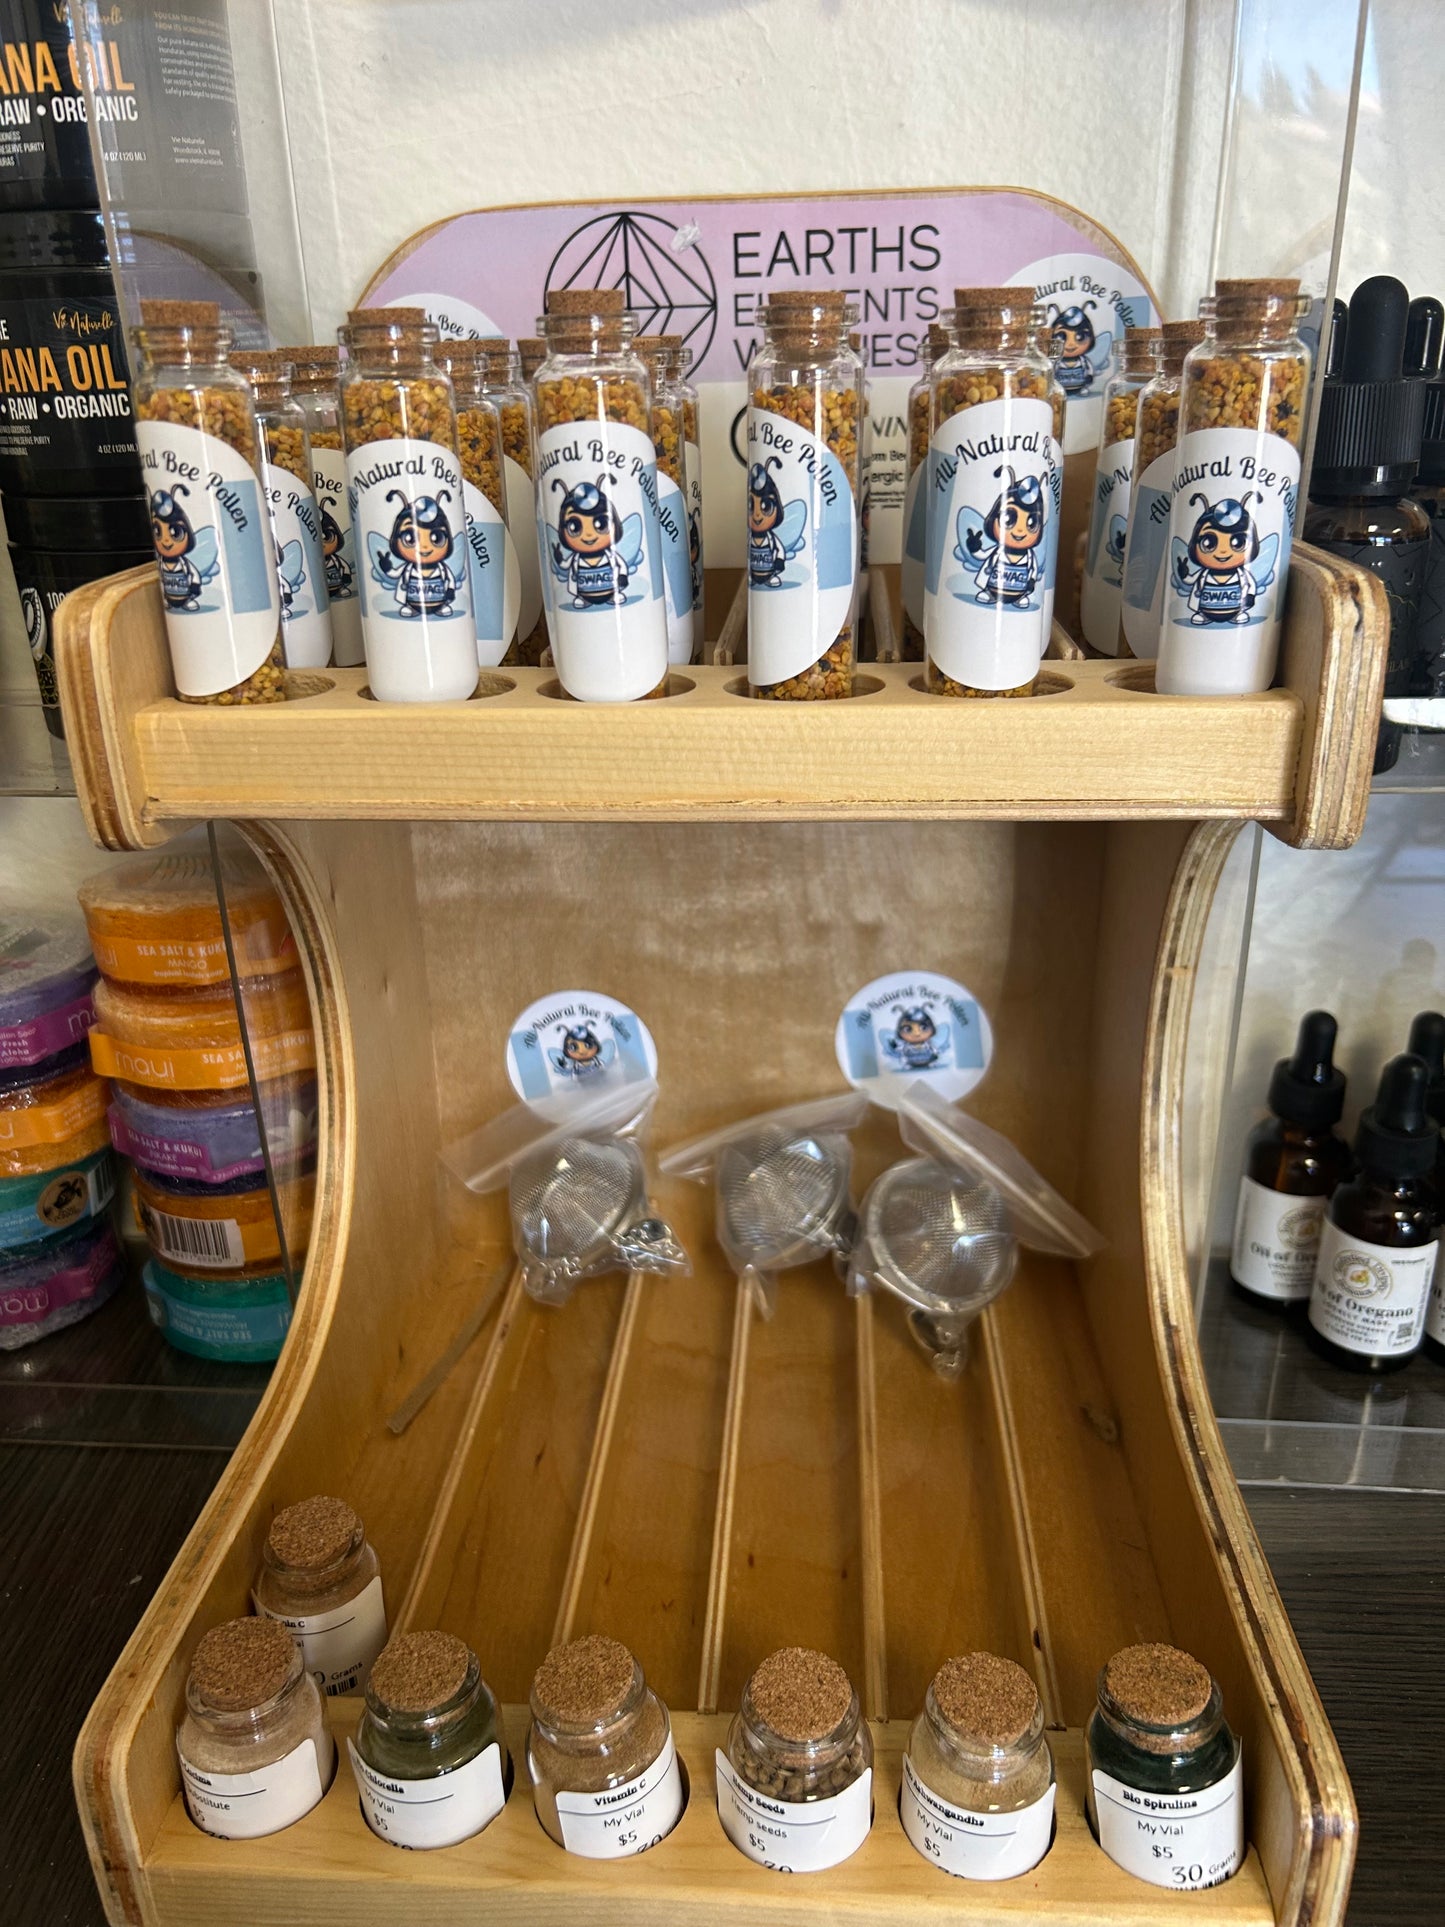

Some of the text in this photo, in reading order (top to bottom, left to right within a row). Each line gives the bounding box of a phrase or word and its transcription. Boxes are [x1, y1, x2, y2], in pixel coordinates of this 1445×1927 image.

[67, 40, 135, 91] OIL
[51, 95, 138, 122] ORGANIC
[734, 225, 941, 277] EARTHS
[1080, 275, 1107, 299] Bee
[734, 287, 939, 327] ENTS
[438, 314, 464, 335] Bee
[0, 344, 127, 393] ANA OIL
[8, 393, 130, 420] RAW ORGANIC
[432, 456, 458, 488] Bee
[761, 422, 794, 454] Bee
[798, 443, 838, 507] Pollen
[1239, 456, 1277, 487] Bee
[314, 471, 343, 494] Bee
[540, 439, 660, 517] atural Bee Pollen
[162, 450, 249, 533] Bee Pollen
[287, 491, 319, 542] Pollen
[658, 503, 680, 543] llen
[578, 573, 613, 587] SWAG
[992, 568, 1028, 583] SWAG
[408, 583, 443, 596] SWAG
[1203, 590, 1238, 602] SWAG
[137, 945, 157, 956] SEA
[160, 945, 184, 957] SALT
[168, 959, 207, 970] MANGO
[2, 1040, 29, 1048] Fresh
[202, 1053, 224, 1064] SEA
[228, 1043, 258, 1062] SAT
[116, 1052, 175, 1079] maui
[1327, 1291, 1414, 1319] of Oregano
[298, 1620, 305, 1628] C
[331, 1662, 363, 1681] Grams
[364, 1769, 405, 1794] Chlorella
[594, 1778, 647, 1807] Vitamin C
[731, 1773, 786, 1815] Hemp Seeds
[1122, 1789, 1198, 1811] Bio Spirulina
[378, 1801, 396, 1815] Vial
[603, 1804, 646, 1829] My Vial
[373, 1812, 389, 1832] $5
[756, 1821, 788, 1839] seeds
[916, 1807, 953, 1842] My Vial
[1137, 1819, 1184, 1836] My Vial
[617, 1829, 638, 1848] $5
[748, 1832, 766, 1853] $5
[923, 1836, 941, 1858] $5
[1151, 1844, 1173, 1860] $5
[1171, 1850, 1237, 1885] 30 Grams
